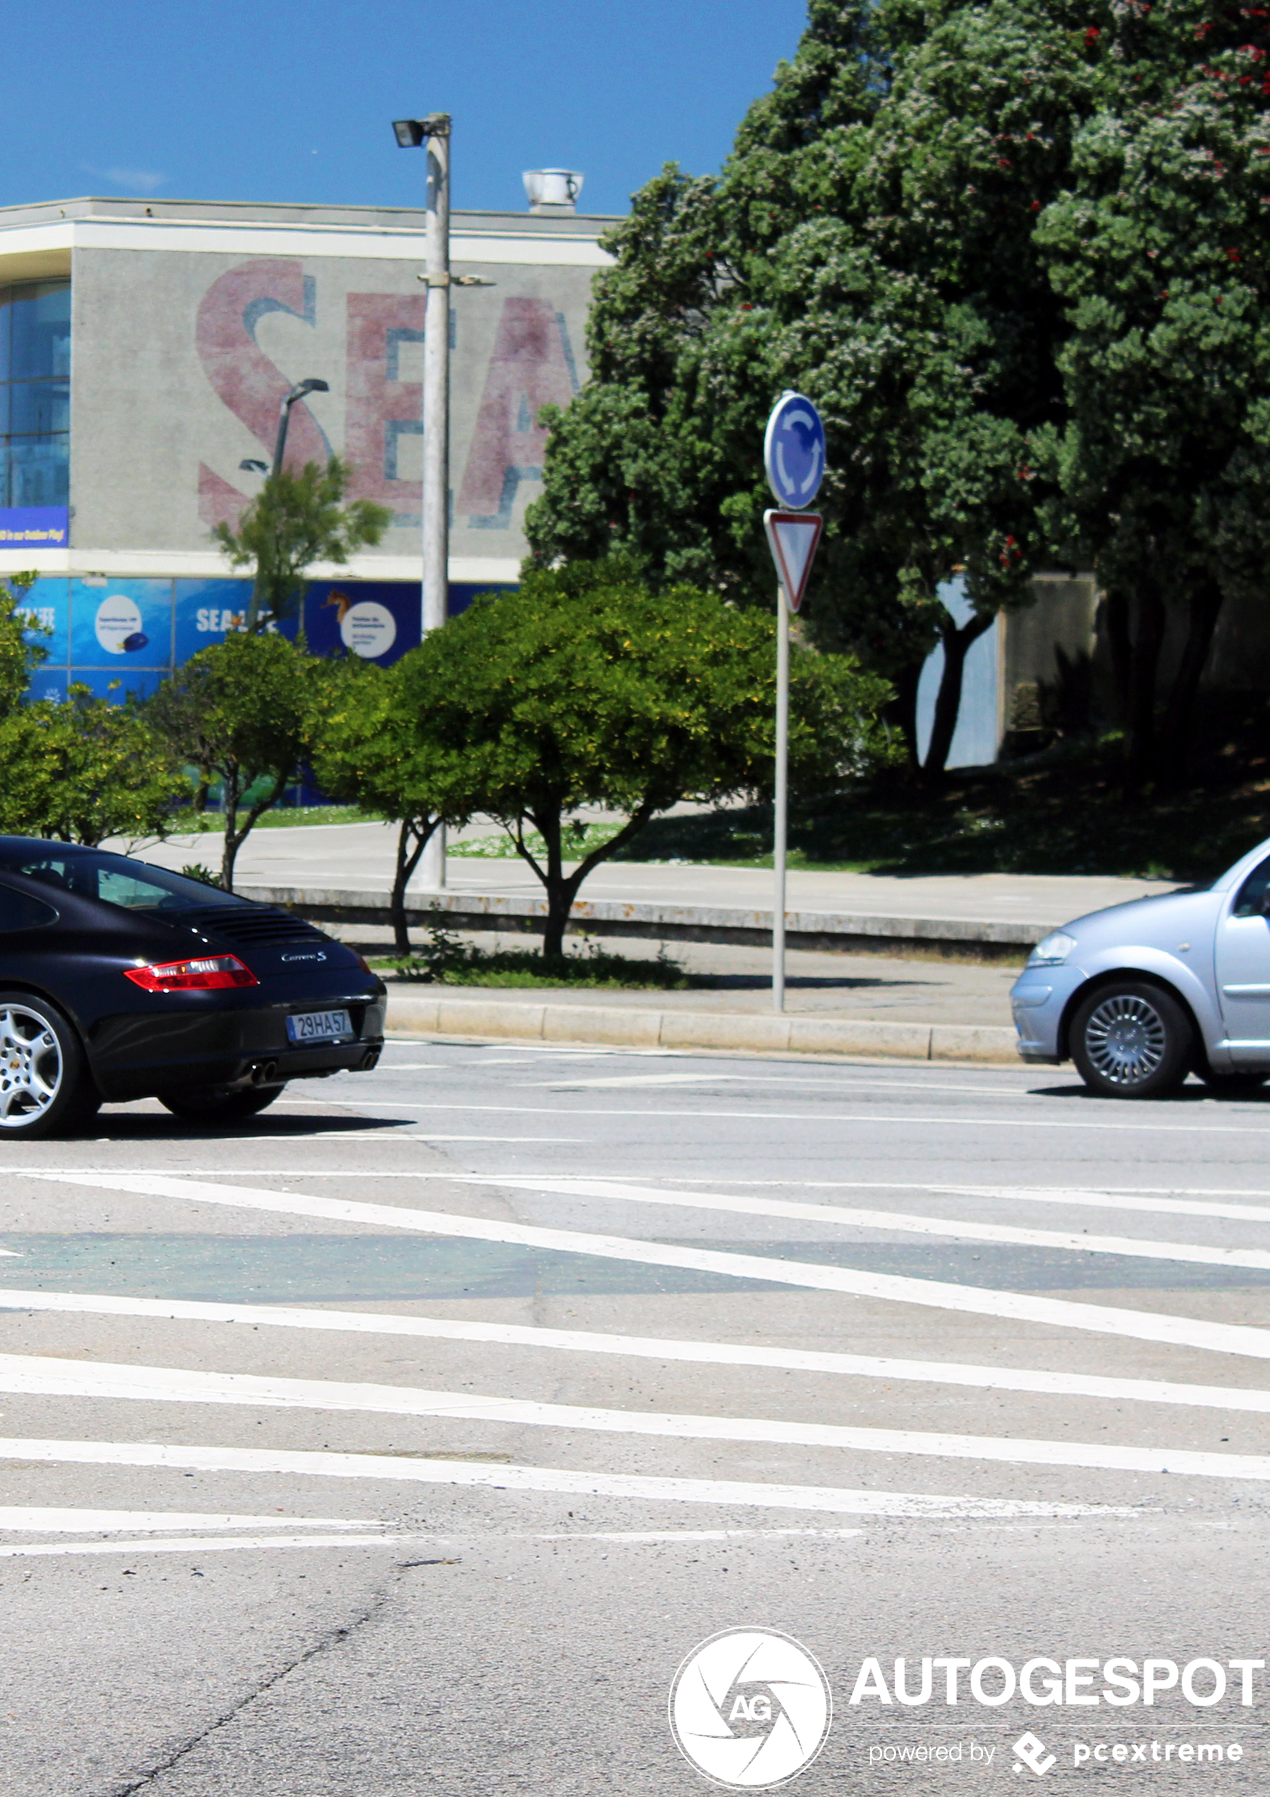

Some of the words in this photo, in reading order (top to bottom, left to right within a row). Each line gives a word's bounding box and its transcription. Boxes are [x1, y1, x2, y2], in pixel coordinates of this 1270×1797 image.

[195, 258, 580, 535] SEA
[196, 608, 234, 632] SEA
[281, 953, 316, 962] Carrera
[317, 951, 327, 962] S
